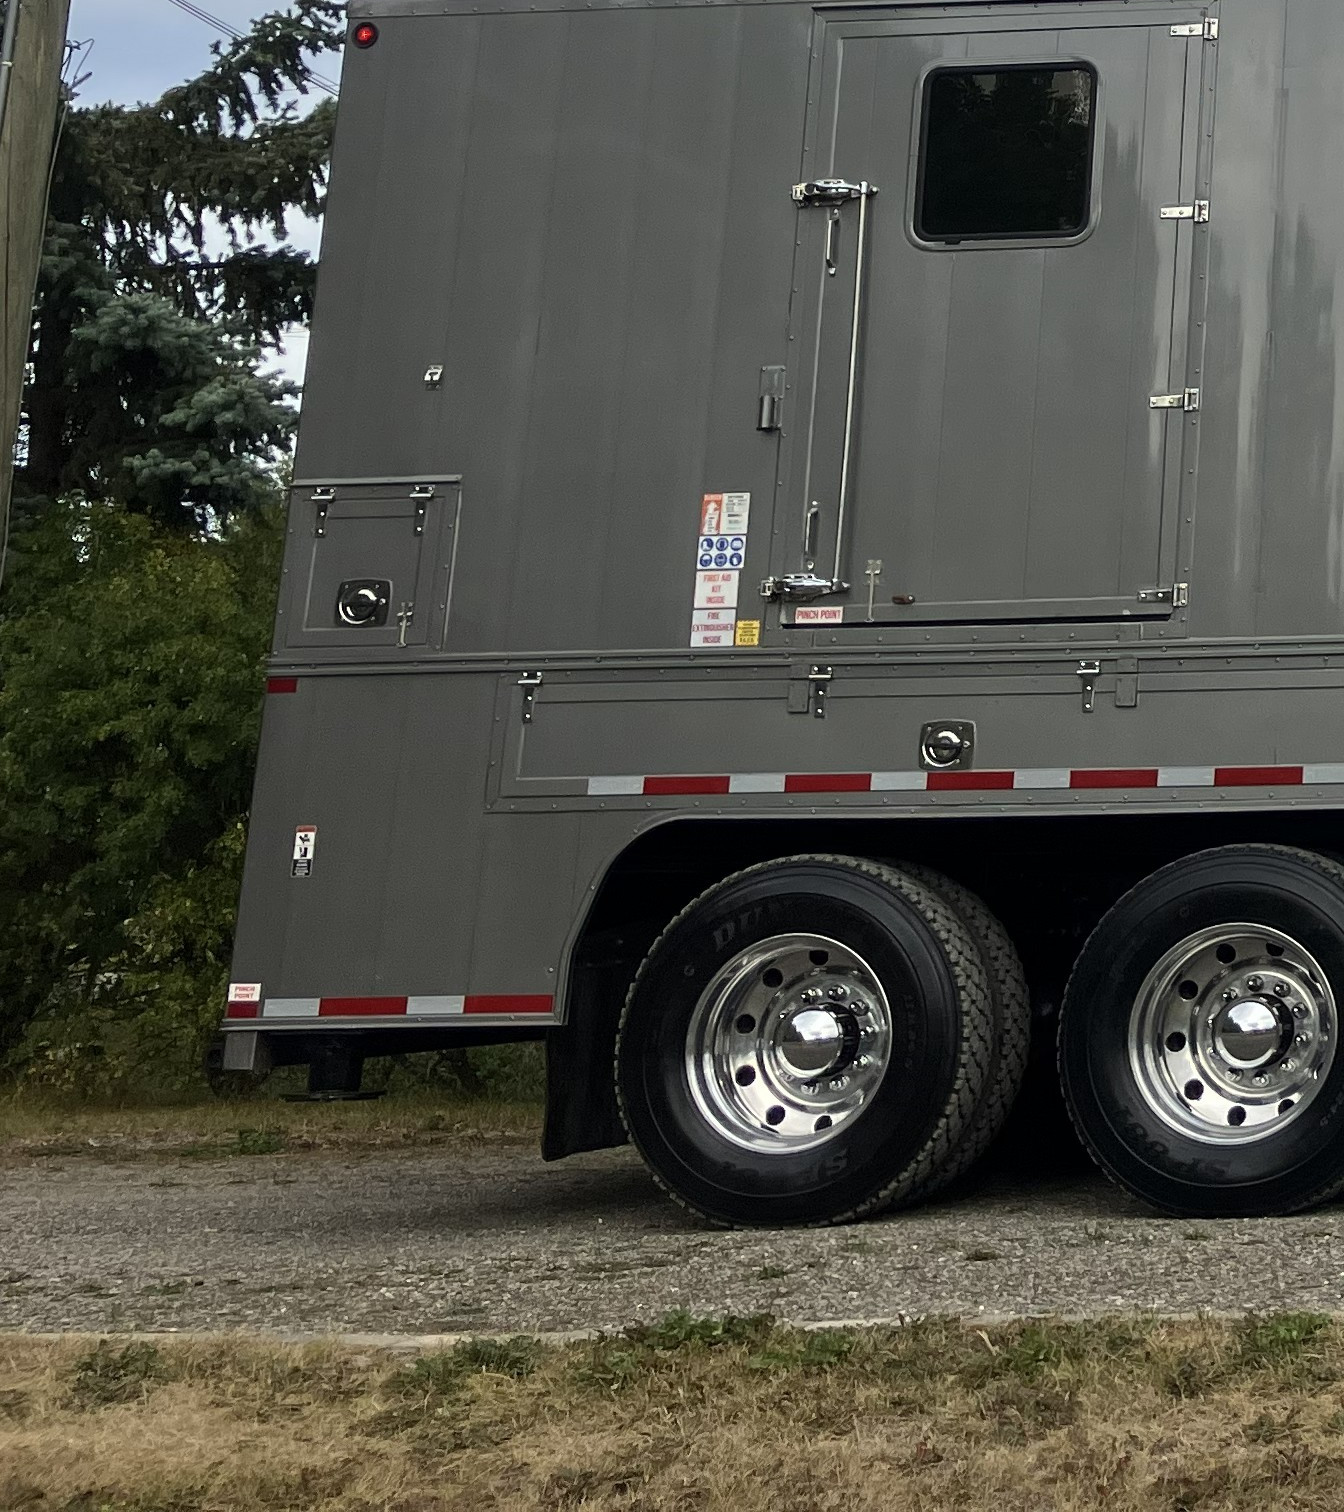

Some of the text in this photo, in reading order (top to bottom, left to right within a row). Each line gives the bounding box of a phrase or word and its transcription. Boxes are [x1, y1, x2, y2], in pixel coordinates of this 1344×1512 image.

[703, 573, 732, 582] FIRST AID
[711, 585, 721, 593] KIT
[706, 596, 725, 604] INSIDE
[707, 612, 720, 620] FIRE
[797, 609, 841, 619] PINCH POINT
[692, 623, 734, 632] EXTINGUISHER
[702, 635, 722, 644] INSIDE
